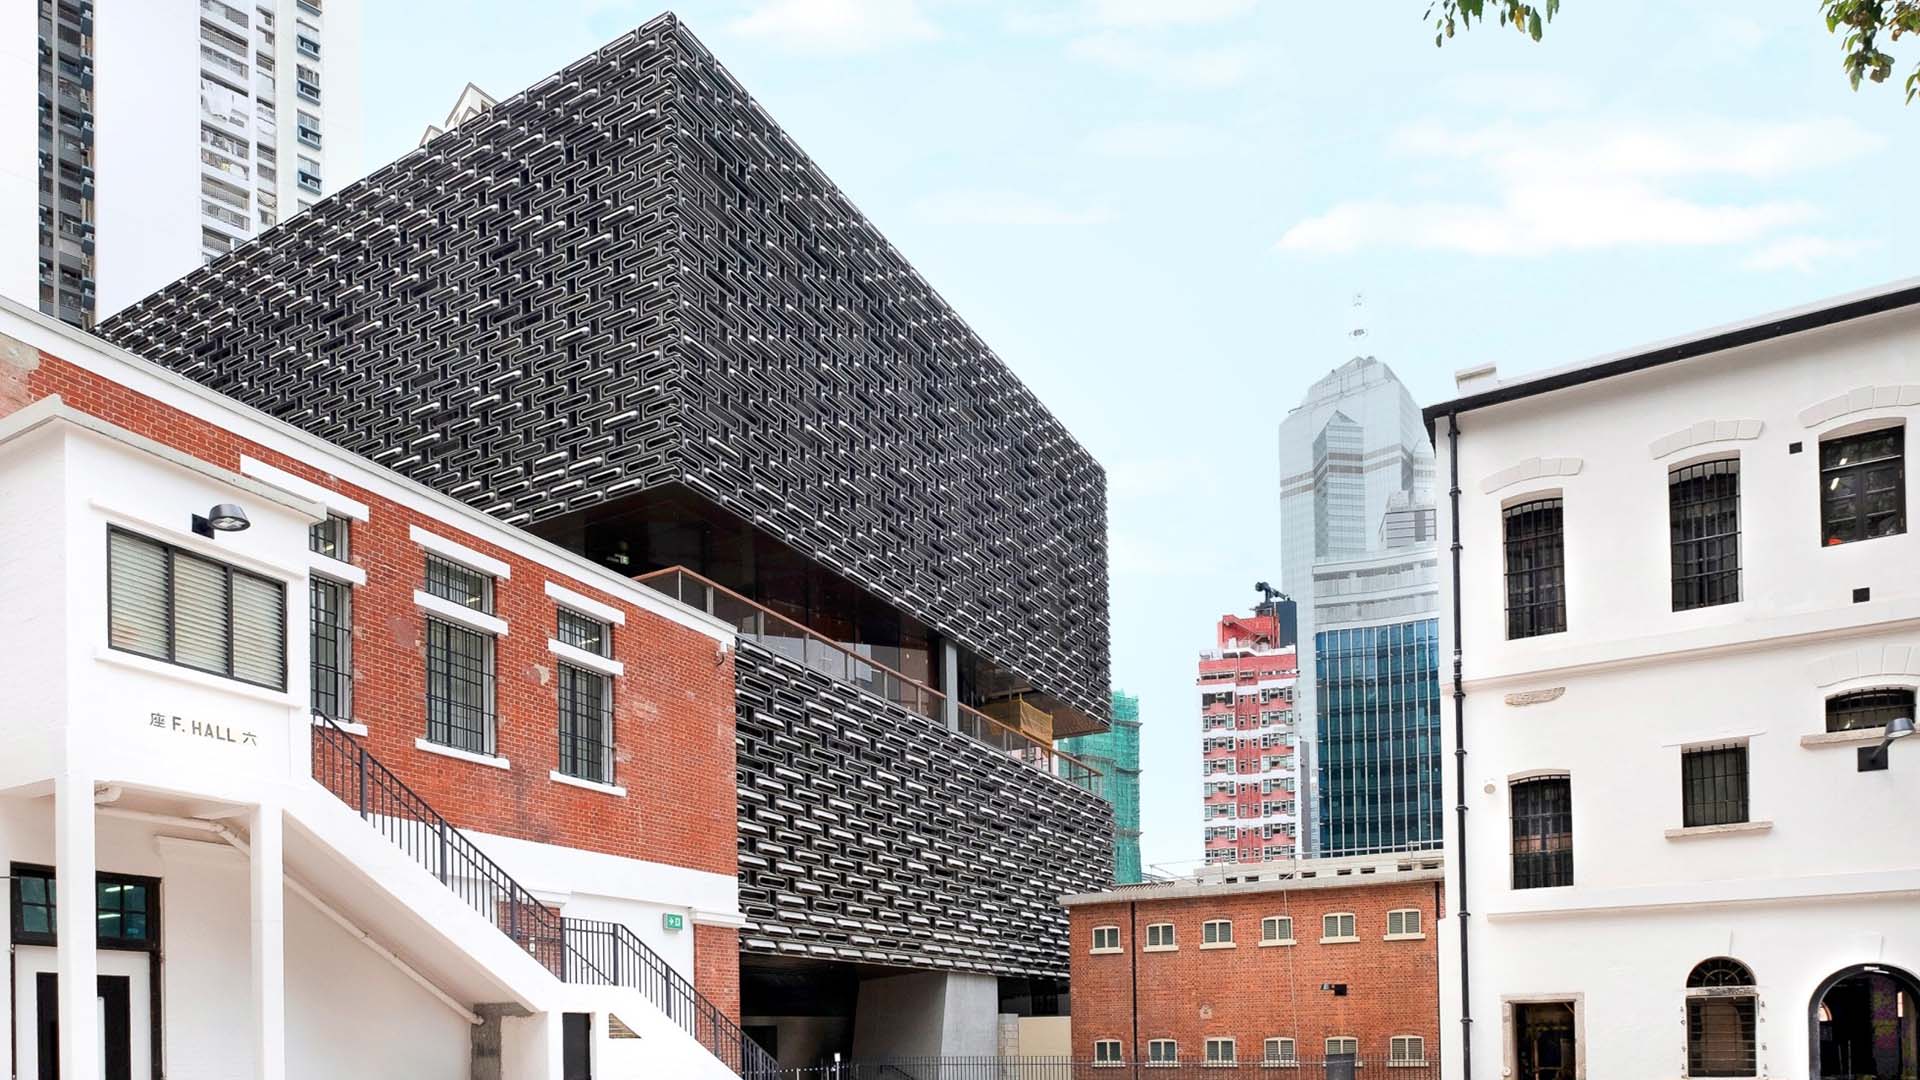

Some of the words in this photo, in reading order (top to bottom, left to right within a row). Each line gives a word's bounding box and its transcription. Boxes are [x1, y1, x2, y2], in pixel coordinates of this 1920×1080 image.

[150, 712, 166, 728] 座
[172, 716, 185, 732] F.
[191, 720, 236, 743] HALL
[242, 731, 257, 746] 六
